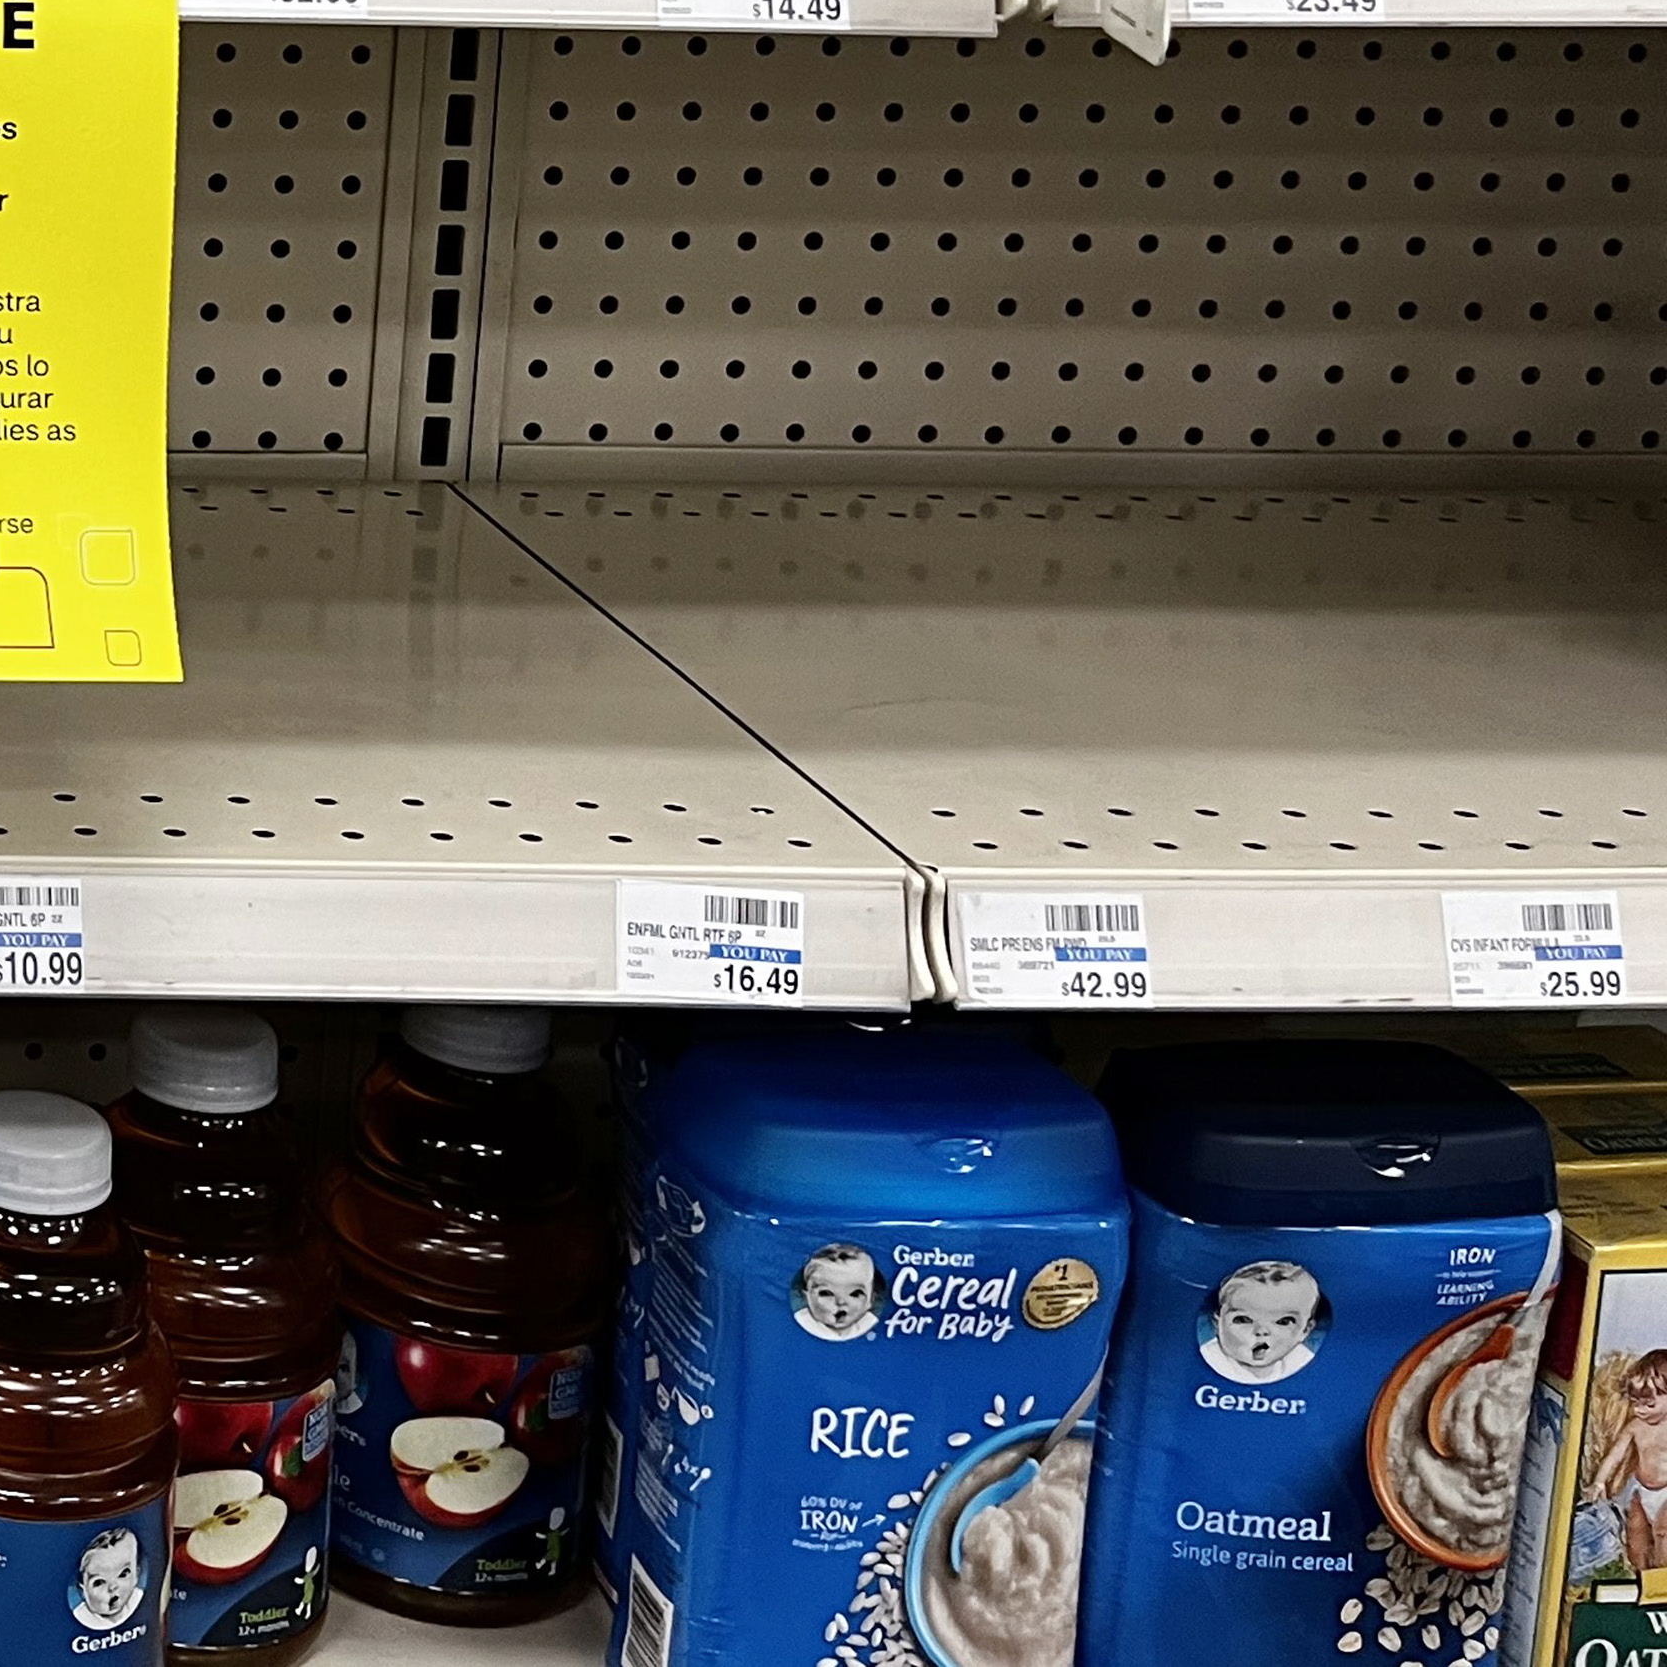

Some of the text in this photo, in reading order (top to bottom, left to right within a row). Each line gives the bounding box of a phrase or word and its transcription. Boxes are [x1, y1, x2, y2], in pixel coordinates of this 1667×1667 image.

[27, 354, 49, 377] lo
[47, 424, 76, 441] as
[31, 913, 45, 927] 6P
[714, 964, 798, 994] $16.49
[1062, 972, 1146, 997] $42.99
[1540, 971, 1620, 996] $25.99
[893, 1245, 974, 1267] Gerber
[1449, 1248, 1496, 1266] IRON
[891, 1268, 1017, 1310] Cereal
[885, 1308, 1014, 1343] for Baby
[1195, 1385, 1306, 1414] Gerber
[810, 1406, 915, 1459] RICE
[800, 1510, 858, 1533] IRON
[1177, 1501, 1331, 1542] Oatmeal
[1172, 1540, 1353, 1572] Single grain cereal
[71, 1626, 140, 1654] Gerber
